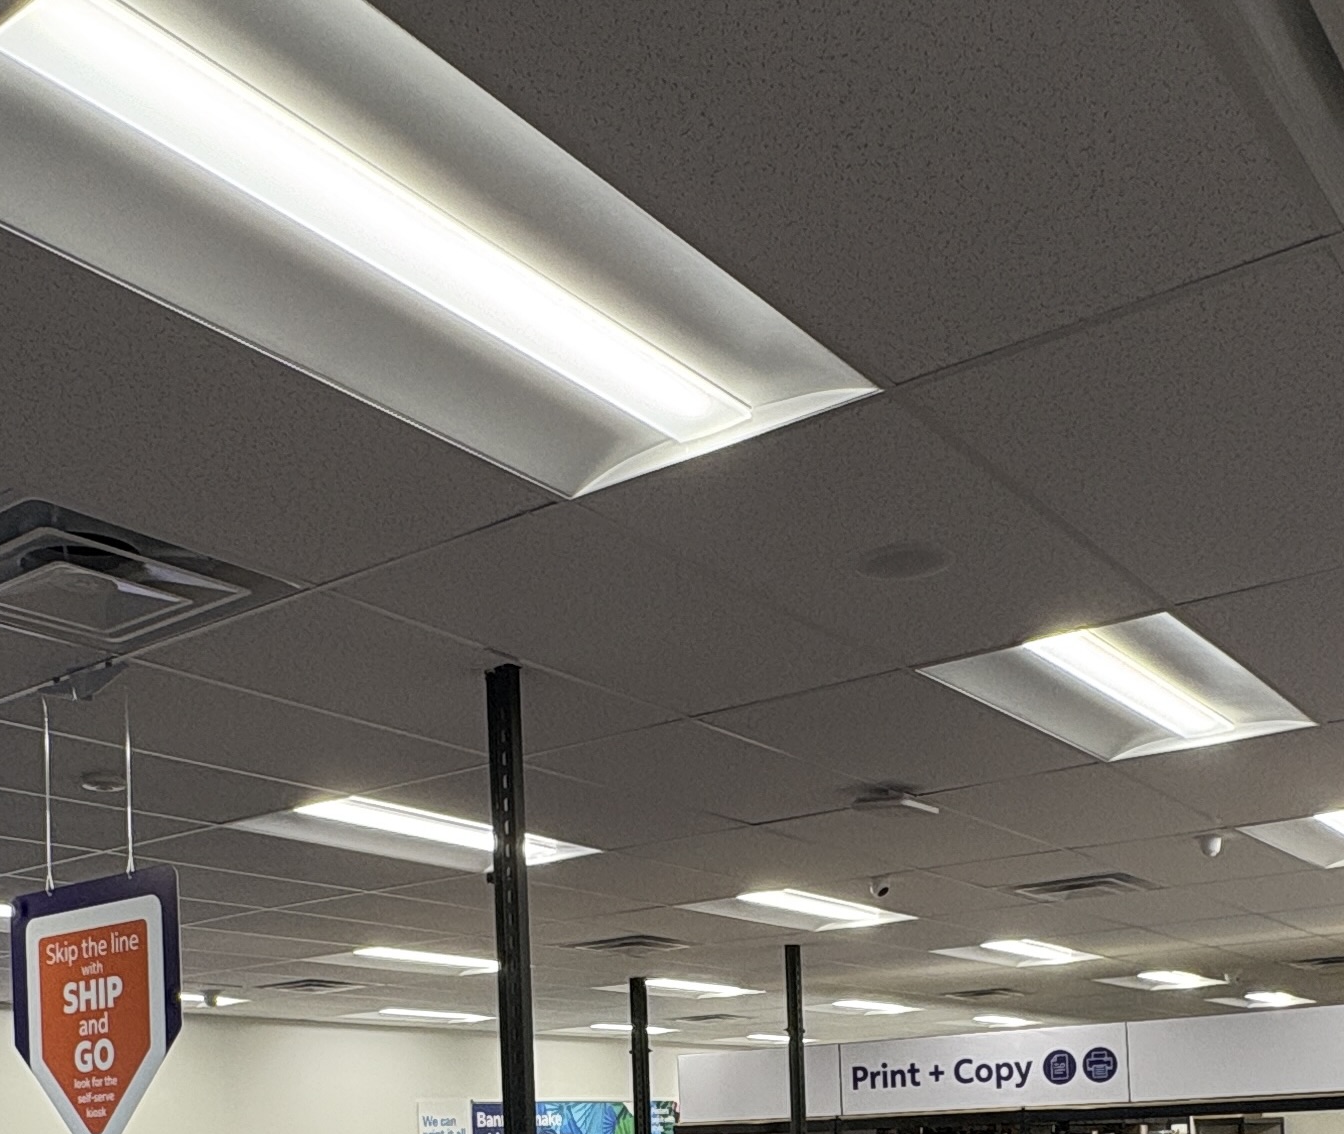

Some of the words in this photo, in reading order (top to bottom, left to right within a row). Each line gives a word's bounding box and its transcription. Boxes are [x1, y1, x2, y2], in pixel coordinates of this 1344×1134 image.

[46, 941, 78, 966] Skip
[81, 937, 107, 959] the
[111, 932, 139, 954] line
[81, 961, 104, 976] with
[63, 976, 123, 1014] SHIP
[79, 1012, 109, 1036] and
[74, 1038, 115, 1073] GO
[73, 1077, 90, 1089] look
[91, 1076, 103, 1087] for
[104, 1075, 118, 1087] the
[852, 1062, 921, 1090] Print
[929, 1064, 945, 1082] +
[954, 1058, 1033, 1089] Copy
[77, 1091, 115, 1104] self-serve
[86, 1106, 107, 1118] kiosk
[422, 1116, 441, 1128] We
[443, 1117, 457, 1128] can
